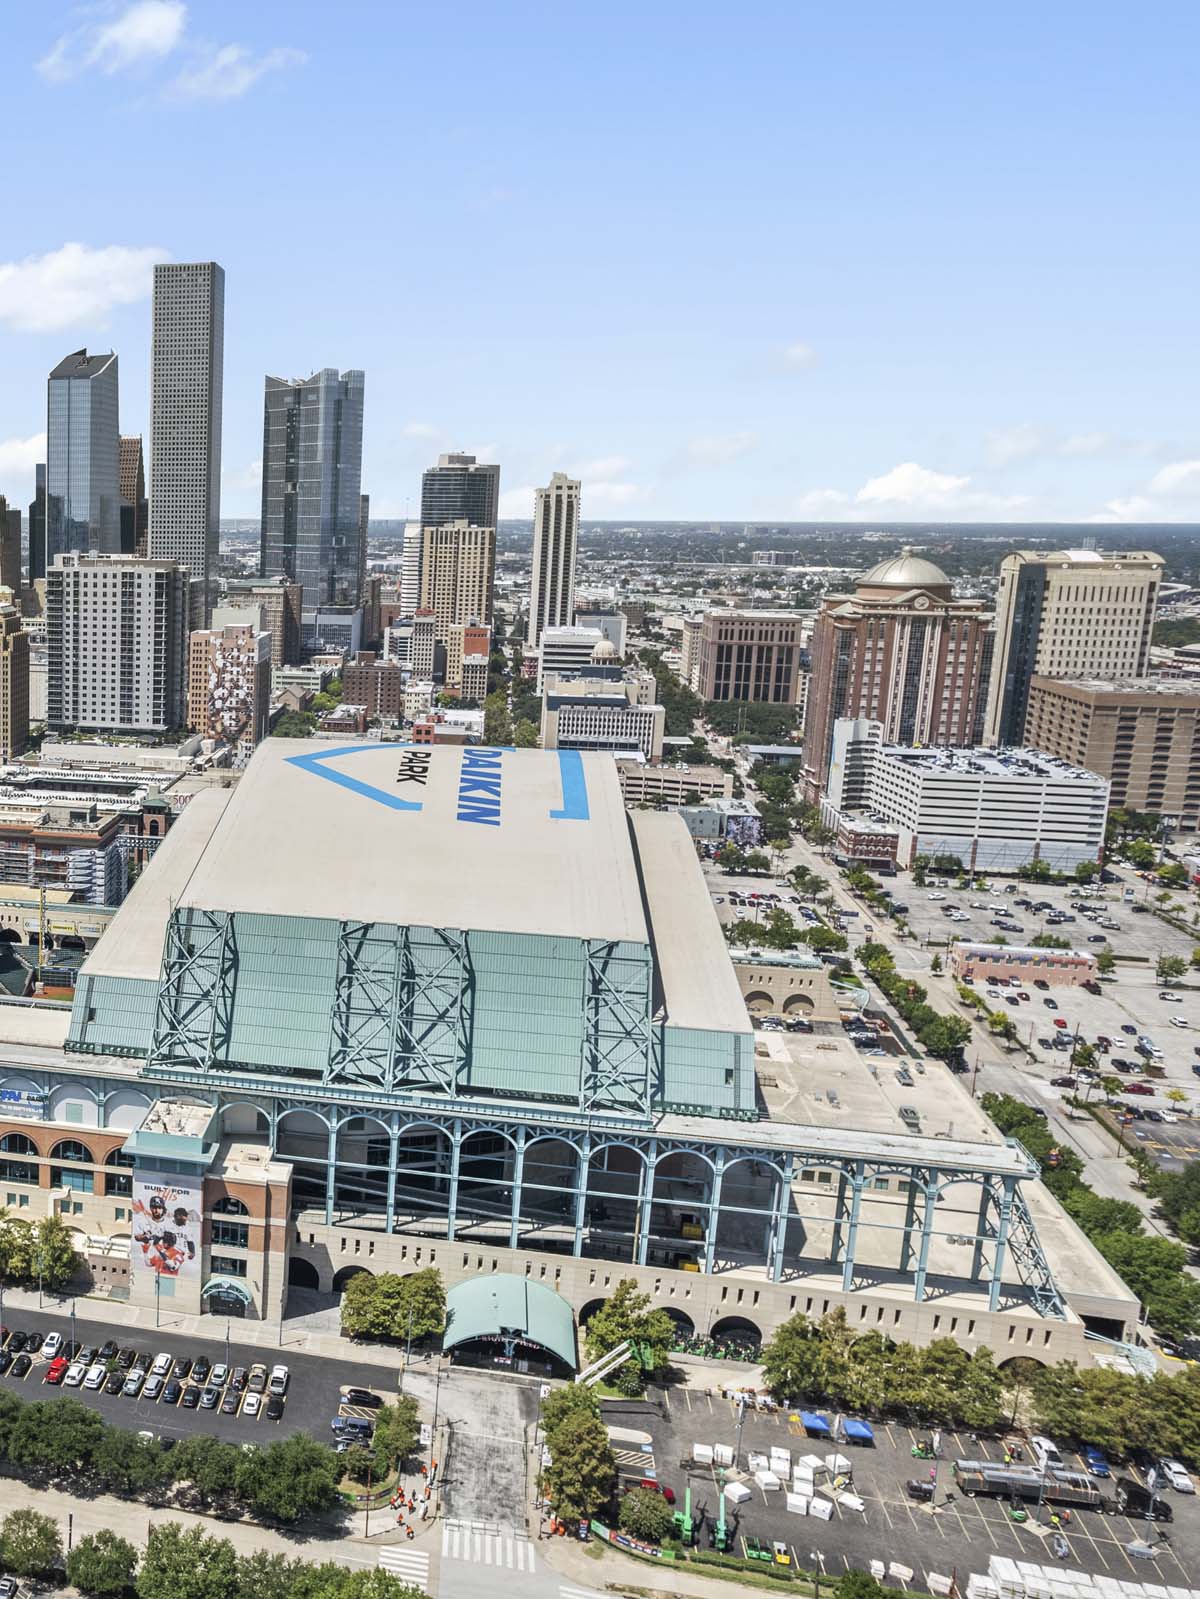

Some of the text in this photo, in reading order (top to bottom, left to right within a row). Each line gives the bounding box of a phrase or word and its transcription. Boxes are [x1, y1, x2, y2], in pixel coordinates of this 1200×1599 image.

[397, 751, 432, 785] PARK
[457, 748, 502, 826] DAIKIN
[144, 1185, 190, 1196] BUILT FOR
